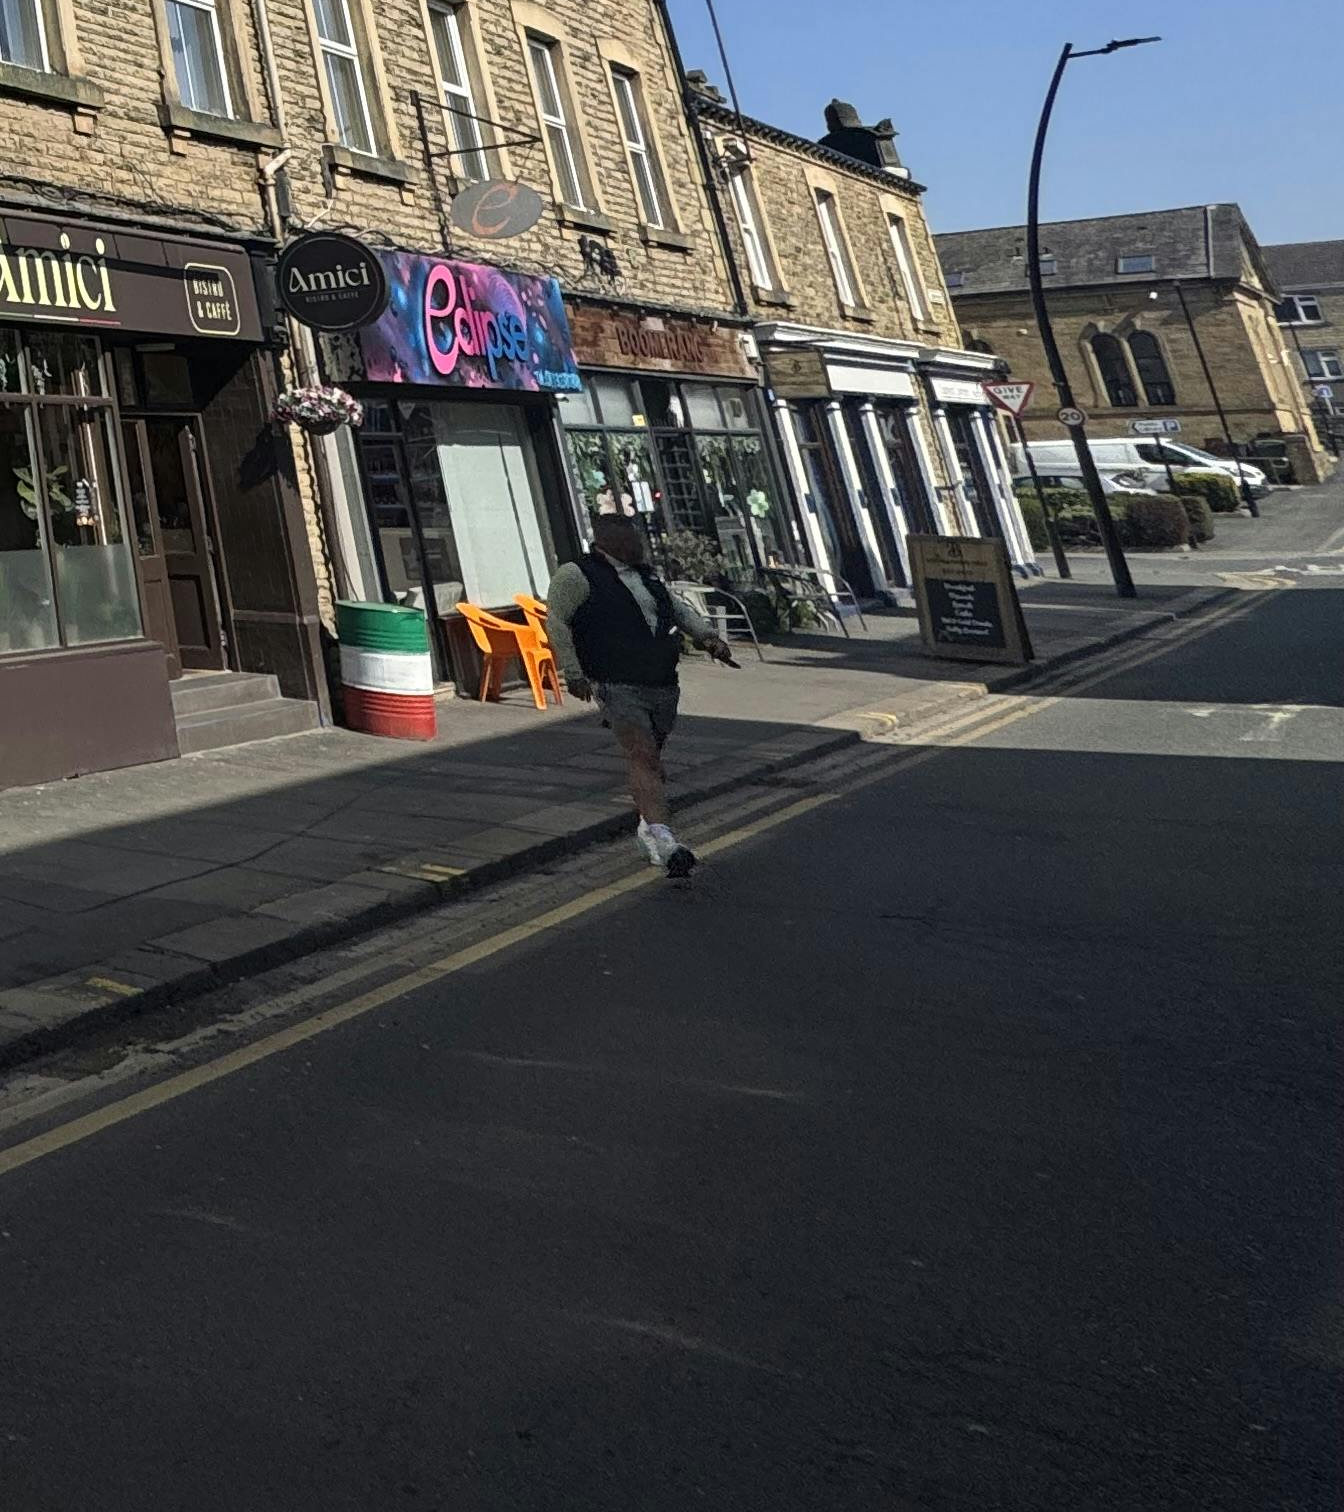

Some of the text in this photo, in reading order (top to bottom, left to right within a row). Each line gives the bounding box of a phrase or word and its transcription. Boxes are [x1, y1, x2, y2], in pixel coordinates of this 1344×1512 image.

[288, 262, 371, 294] Amici
[615, 324, 704, 364] BOOMERANG
[992, 385, 1025, 395] GIVE
[1060, 410, 1081, 422] 20
